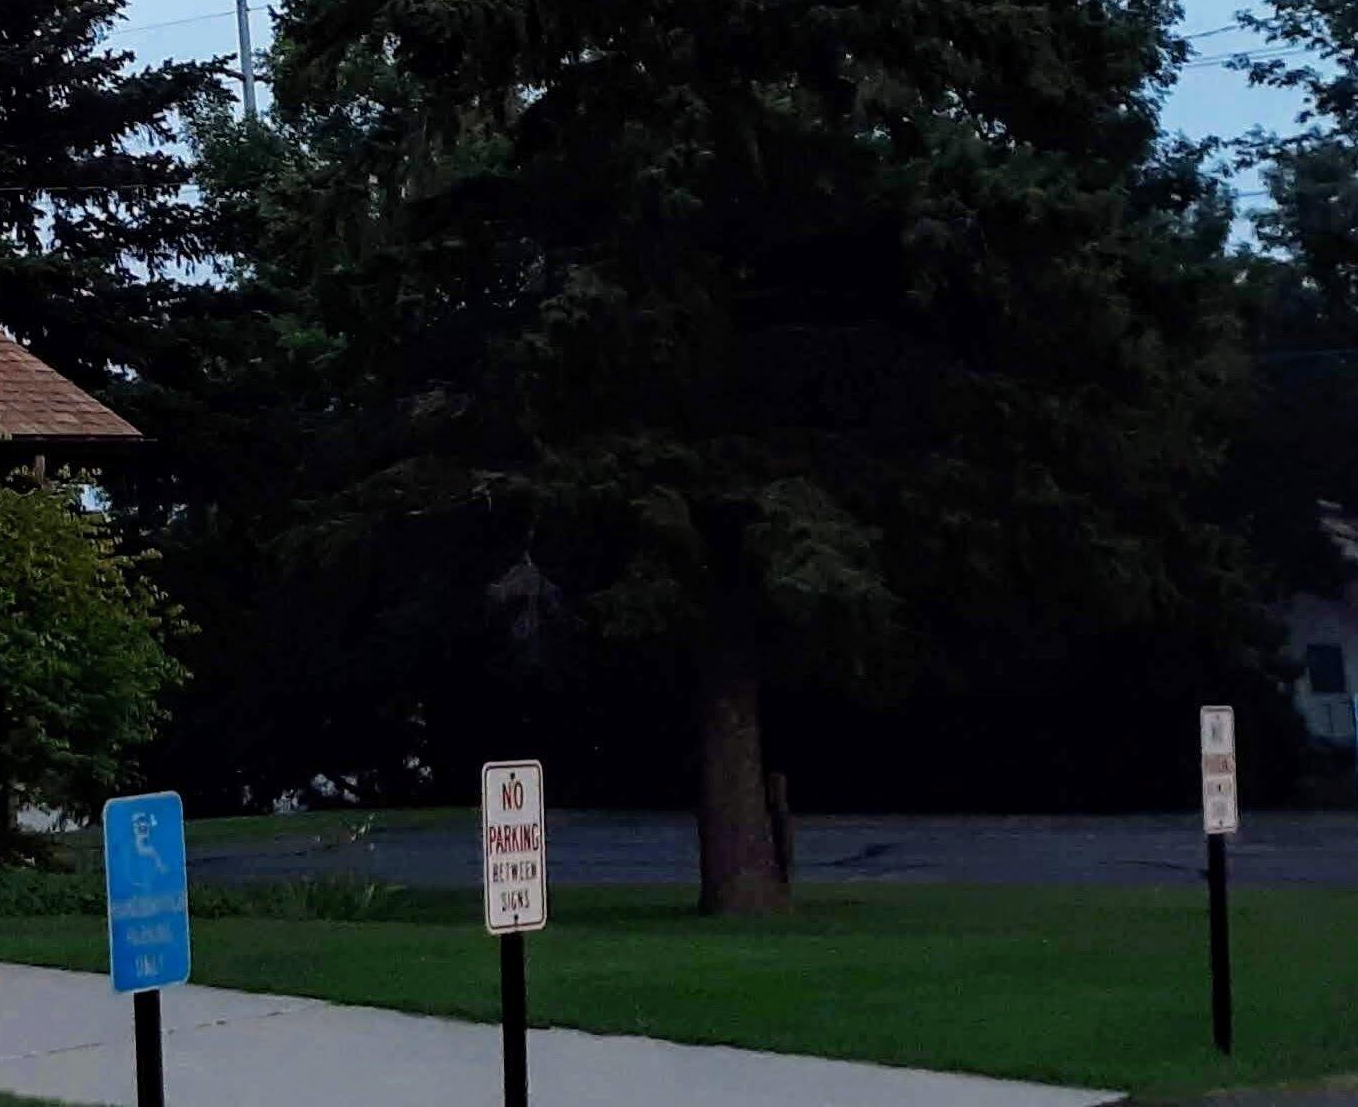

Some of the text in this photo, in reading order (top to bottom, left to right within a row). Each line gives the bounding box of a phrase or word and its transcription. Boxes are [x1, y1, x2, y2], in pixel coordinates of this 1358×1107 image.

[502, 782, 524, 811] NO
[489, 823, 540, 855] PARKING
[492, 861, 537, 883] BETWEEN
[501, 890, 530, 912] SIGNS
